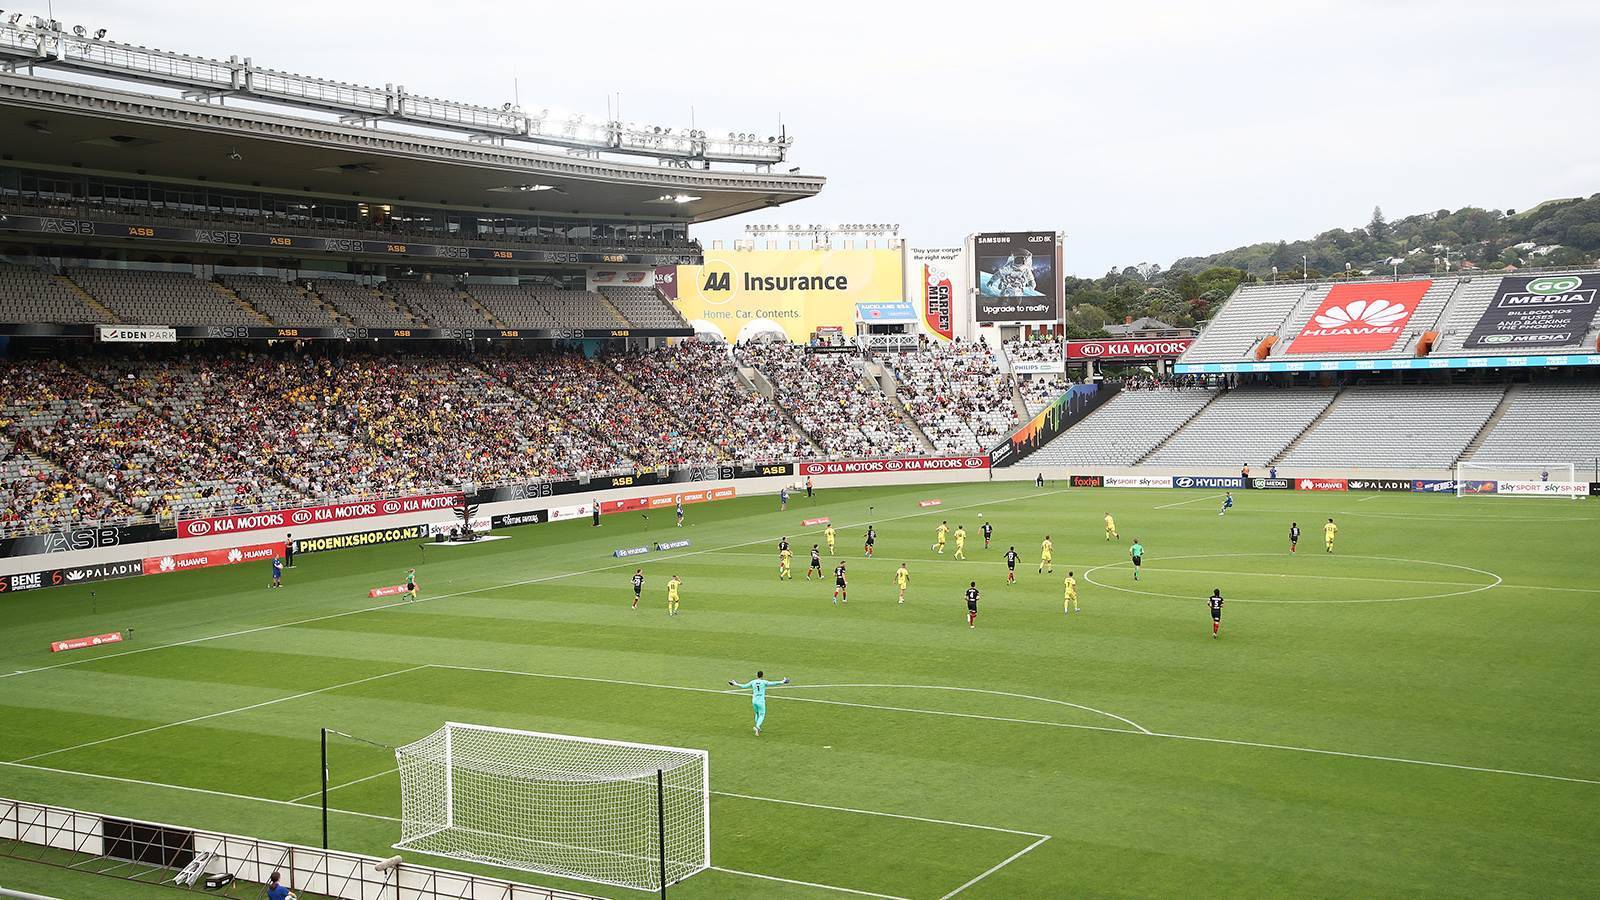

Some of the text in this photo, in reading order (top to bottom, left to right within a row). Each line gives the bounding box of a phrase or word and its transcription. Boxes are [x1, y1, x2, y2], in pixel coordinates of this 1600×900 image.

[40, 217, 95, 235] ASB
[129, 227, 154, 236] ASB
[194, 230, 241, 245] ASB
[270, 237, 292, 245] ASB
[325, 238, 363, 252] ASB
[387, 244, 406, 252] ASB
[494, 250, 512, 259] ASB
[603, 254, 624, 262] ASB
[703, 272, 848, 291] AA Insurance
[1532, 280, 1576, 291] GO
[928, 286, 938, 315] MILL
[1508, 294, 1585, 304] MEDIA
[703, 309, 802, 318] Home. Car. Contents.
[938, 286, 949, 331] CARPET
[983, 305, 1016, 314] Upgrade
[1026, 304, 1050, 313] reality
[120, 331, 175, 340] EDEN PARK
[208, 326, 249, 338] ASB
[1302, 326, 1401, 336] HUAWEI
[1108, 345, 1130, 354] KIA
[1133, 342, 1186, 354] MOTORS
[762, 466, 786, 475] ASB
[828, 464, 843, 472] KIA
[845, 462, 884, 472] MOTORS
[905, 461, 920, 469] KIA
[923, 459, 962, 468] MOTORS
[612, 476, 633, 486] ASB
[1074, 478, 1100, 486] foxtel
[511, 482, 553, 500] ASB
[1500, 484, 1514, 492] sky
[1544, 484, 1560, 492] sky
[214, 520, 234, 532] KIA
[237, 514, 284, 529] MOTORS
[314, 509, 332, 520] KIA
[335, 504, 376, 518] MOTORS
[404, 499, 421, 511] KIA
[431, 525, 442, 534] sky
[44, 526, 120, 554] ASB
[300, 528, 418, 552] PHOENIXSHOP.CO.NZ
[244, 549, 272, 559] HUAWEI
[178, 557, 208, 568] HUAWEI
[86, 564, 141, 580] PALADIN
[11, 573, 42, 586] BENE
